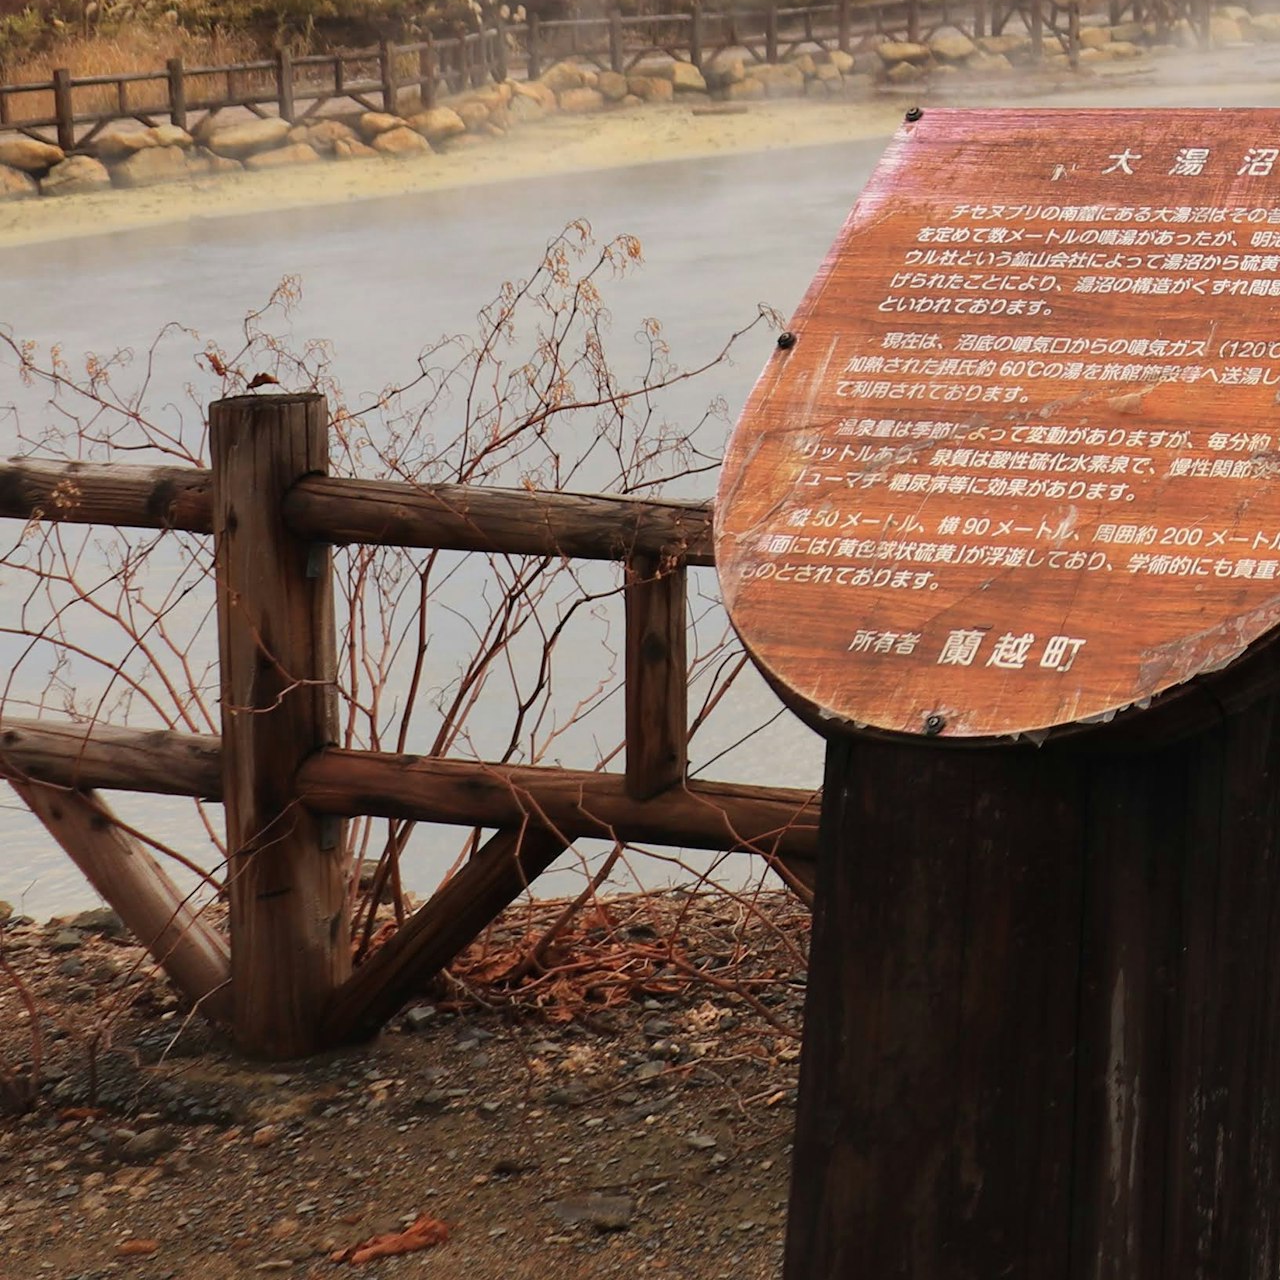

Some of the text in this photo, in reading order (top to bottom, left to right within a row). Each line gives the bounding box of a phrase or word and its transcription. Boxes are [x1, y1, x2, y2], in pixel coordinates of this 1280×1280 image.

[1101, 147, 1279, 178] 大湯沼
[878, 295, 1053, 317] といわれております。
[835, 380, 1029, 404] て利用されております。
[848, 628, 1087, 673] 所有者 蘭越町
